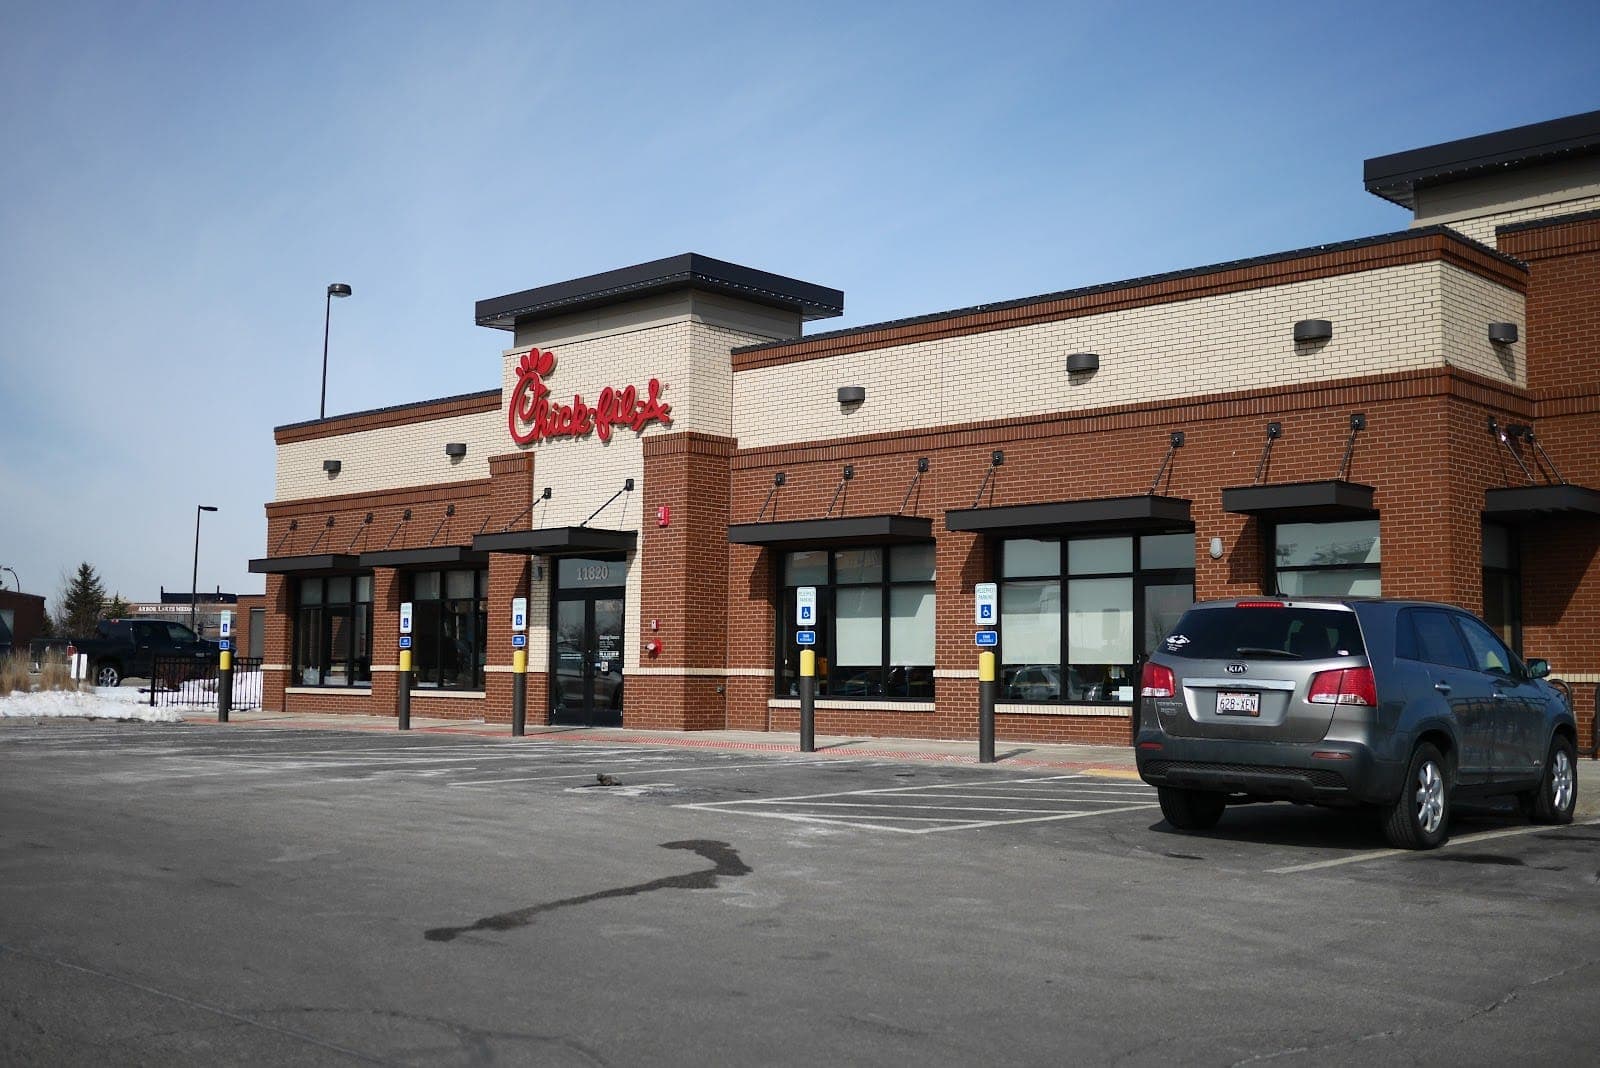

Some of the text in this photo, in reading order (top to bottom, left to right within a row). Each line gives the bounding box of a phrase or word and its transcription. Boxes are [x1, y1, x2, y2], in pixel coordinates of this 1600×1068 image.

[508, 370, 672, 445] Chick-fil-A
[576, 566, 609, 581] 11820
[1228, 664, 1244, 673] KIA
